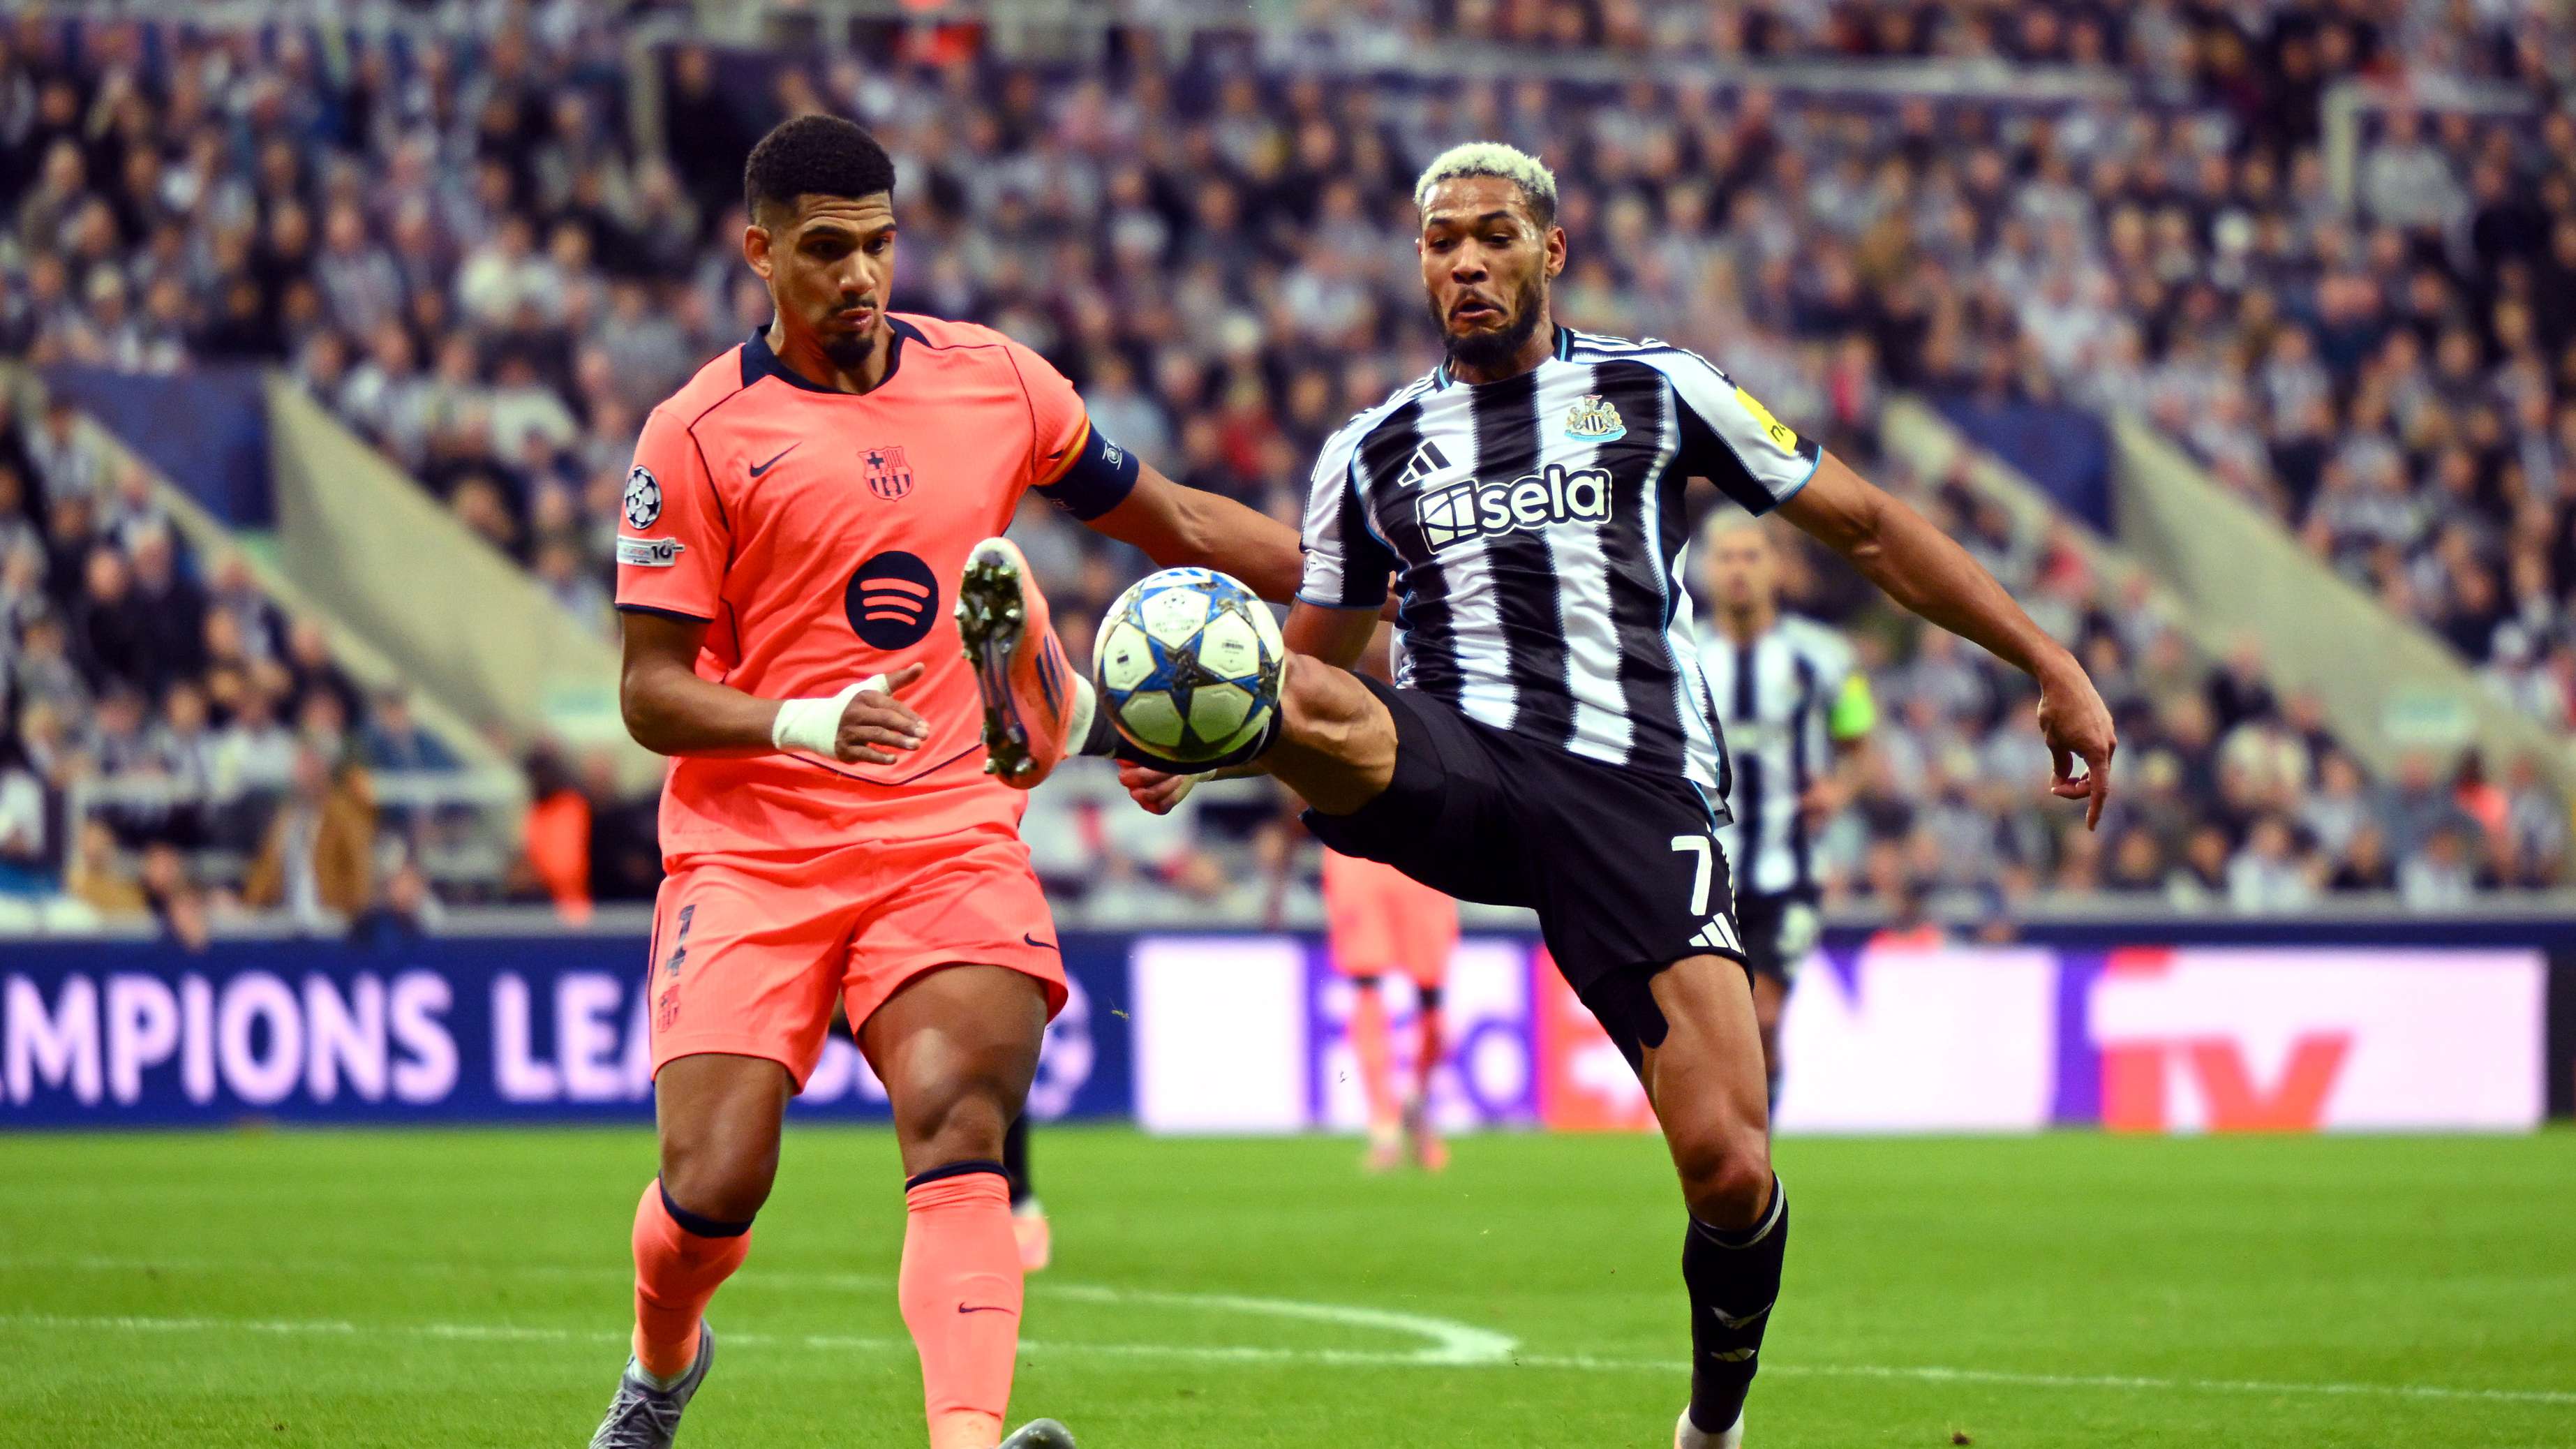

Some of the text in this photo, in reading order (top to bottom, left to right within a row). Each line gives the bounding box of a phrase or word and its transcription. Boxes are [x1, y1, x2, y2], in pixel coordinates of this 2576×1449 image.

[1480, 468, 1605, 529] sela
[1671, 835, 1713, 916] 7
[0, 970, 460, 1104] MPIONS
